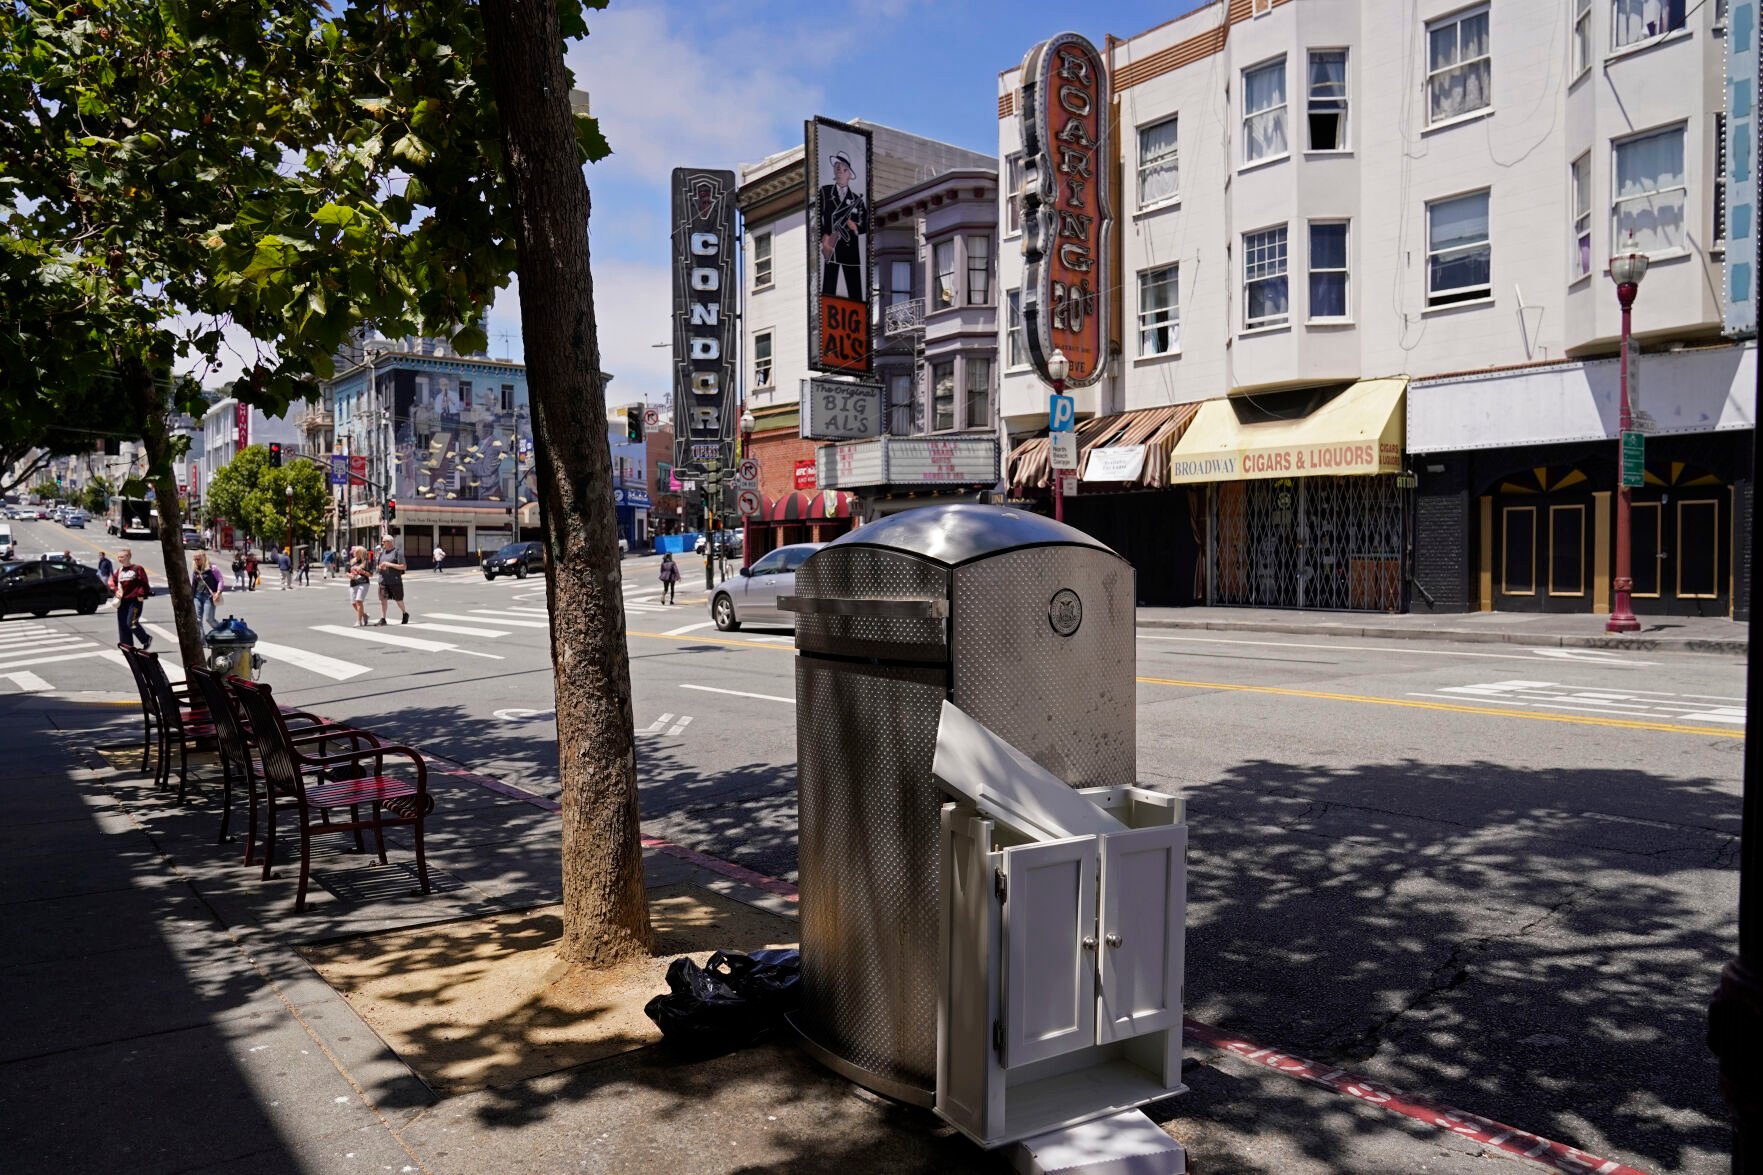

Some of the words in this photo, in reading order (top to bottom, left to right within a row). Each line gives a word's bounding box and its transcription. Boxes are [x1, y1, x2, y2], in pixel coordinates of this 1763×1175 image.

[1057, 51, 1096, 272] ROARING
[690, 232, 720, 430] CONDOR
[826, 304, 861, 334] BIG
[823, 333, 863, 363] AL'S
[815, 384, 835, 393] The
[835, 386, 877, 398] Original
[823, 395, 867, 416] BIG
[824, 415, 869, 434] AL'S
[1054, 399, 1072, 428] P
[1053, 458, 1071, 466] Garage
[1174, 458, 1236, 477] BROADWAY
[1242, 452, 1291, 474] CIGARS
[1296, 449, 1306, 470] &
[1310, 444, 1374, 468] LIQUORS
[1380, 443, 1399, 454] CIGARS
